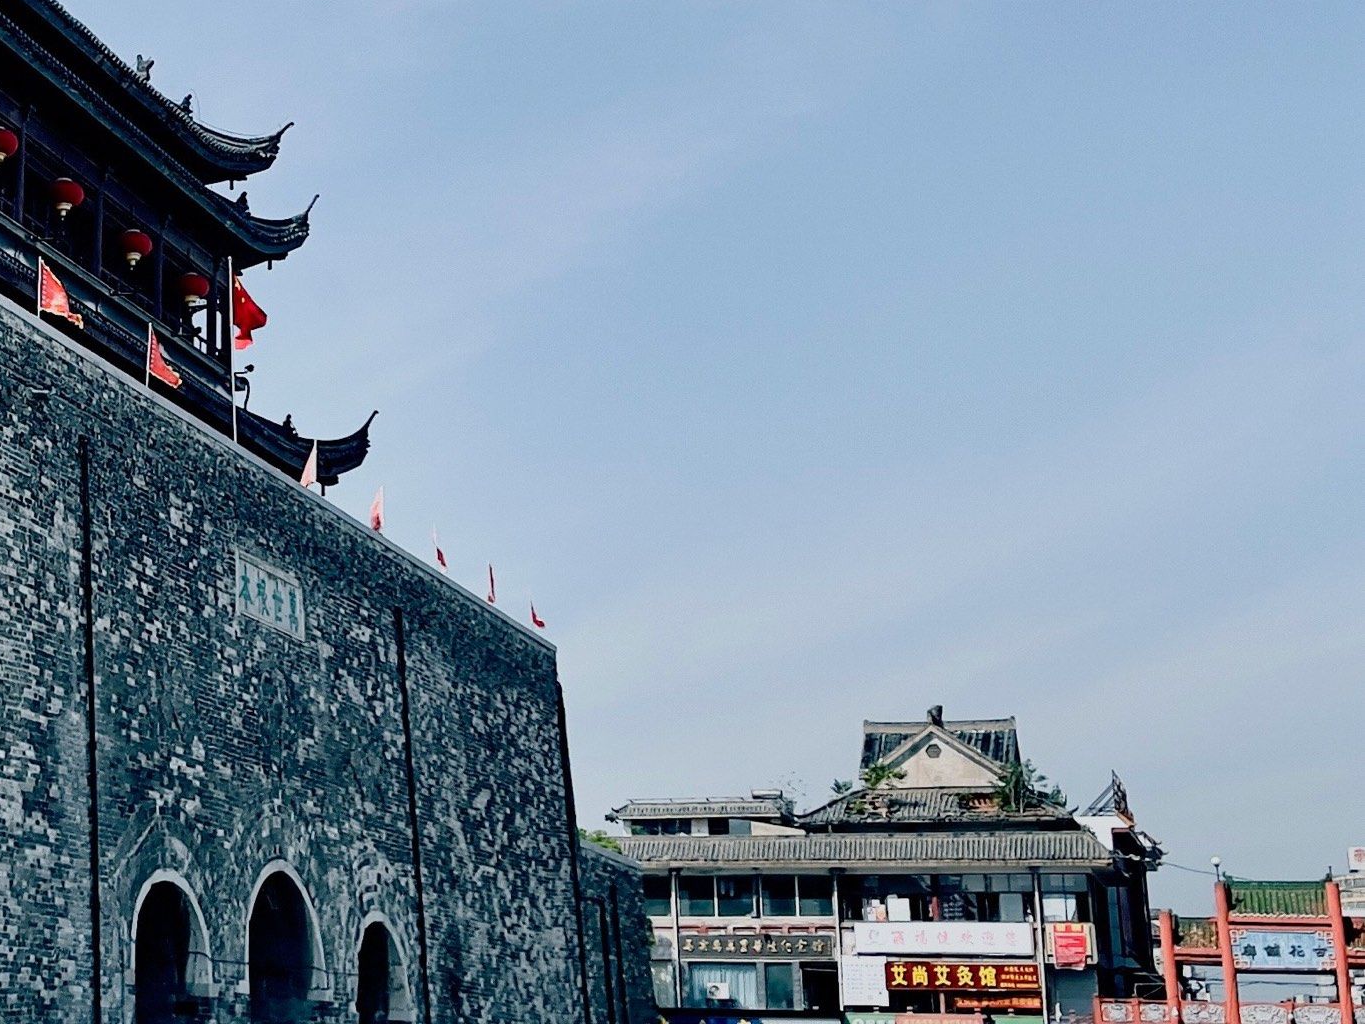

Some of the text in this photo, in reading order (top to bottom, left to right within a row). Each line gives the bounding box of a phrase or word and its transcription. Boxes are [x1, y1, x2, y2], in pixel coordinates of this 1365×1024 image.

[890, 965, 997, 987] 艾尚艾灸馆
